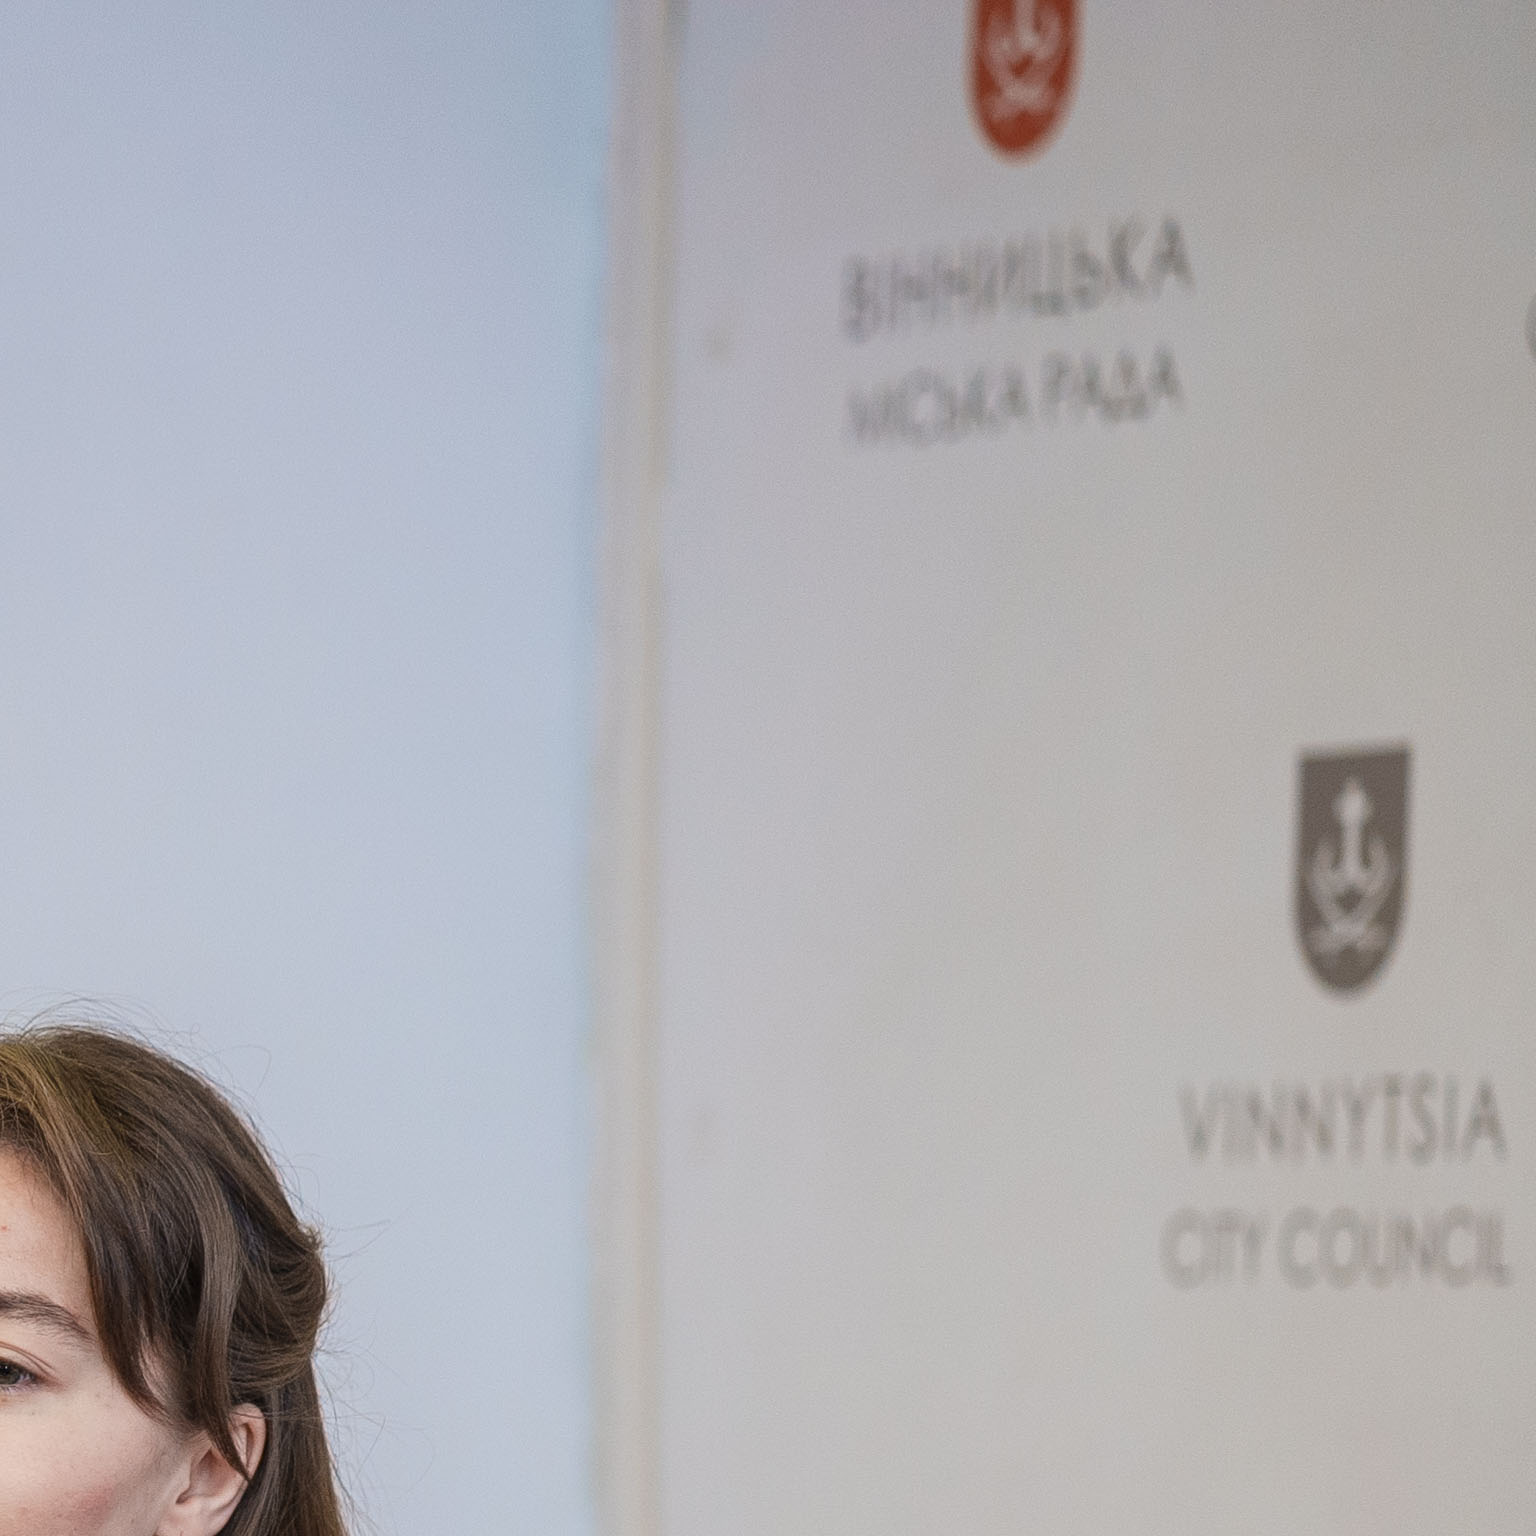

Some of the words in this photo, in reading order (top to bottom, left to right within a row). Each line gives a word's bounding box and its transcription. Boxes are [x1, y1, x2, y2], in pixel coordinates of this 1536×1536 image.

[1177, 1070, 1508, 1168] VINNYTSIA
[1159, 1204, 1268, 1291] CITY
[1277, 1203, 1512, 1291] COUNCIL
